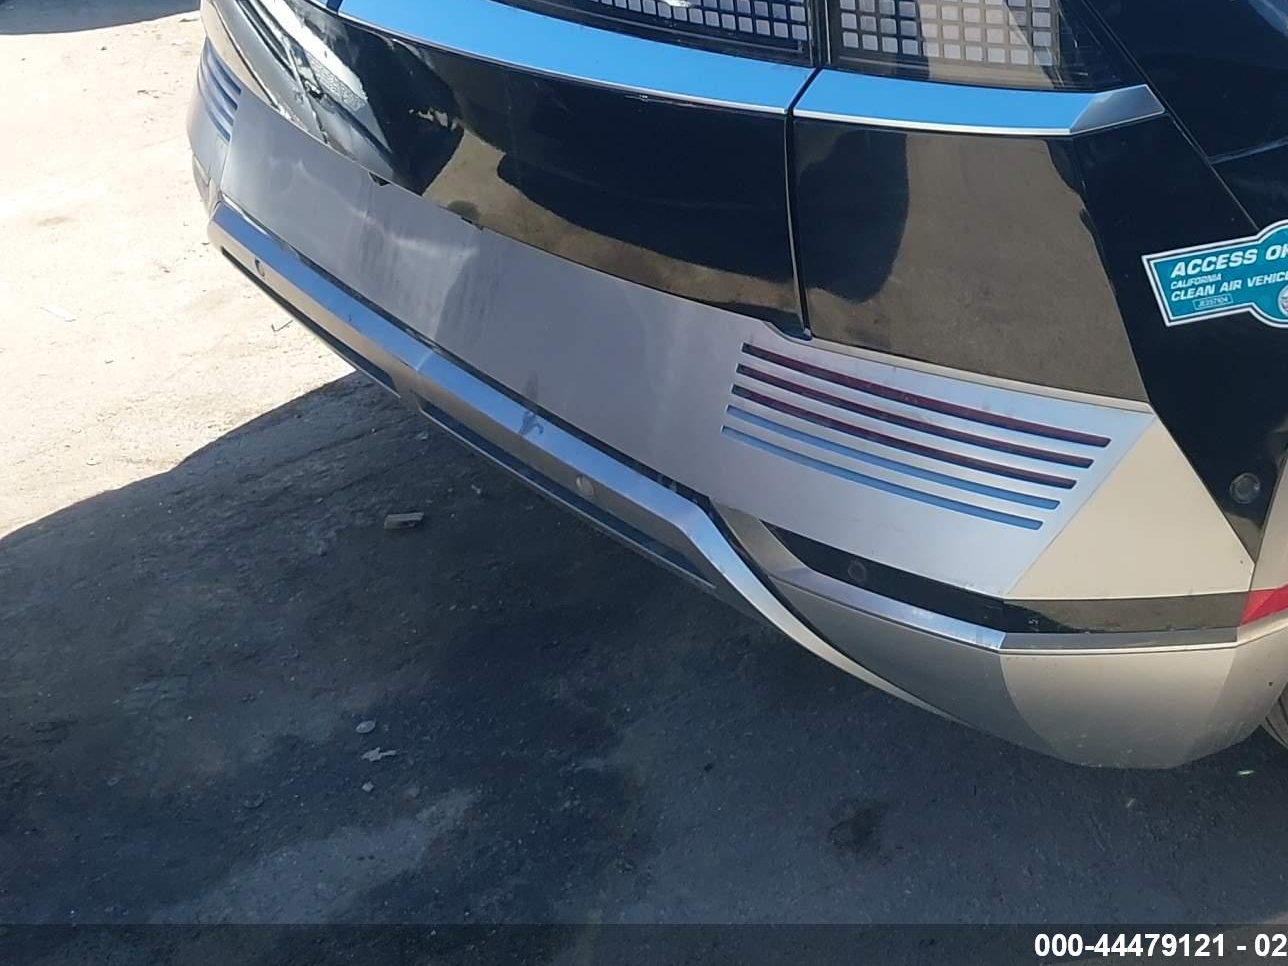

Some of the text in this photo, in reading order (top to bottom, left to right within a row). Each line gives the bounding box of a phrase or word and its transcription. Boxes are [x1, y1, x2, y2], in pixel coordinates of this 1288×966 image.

[1170, 248, 1258, 278] ACCESS
[1170, 273, 1222, 289] CALIFORNIA
[1171, 284, 1216, 302] CLEAN
[1220, 279, 1242, 293] AIR
